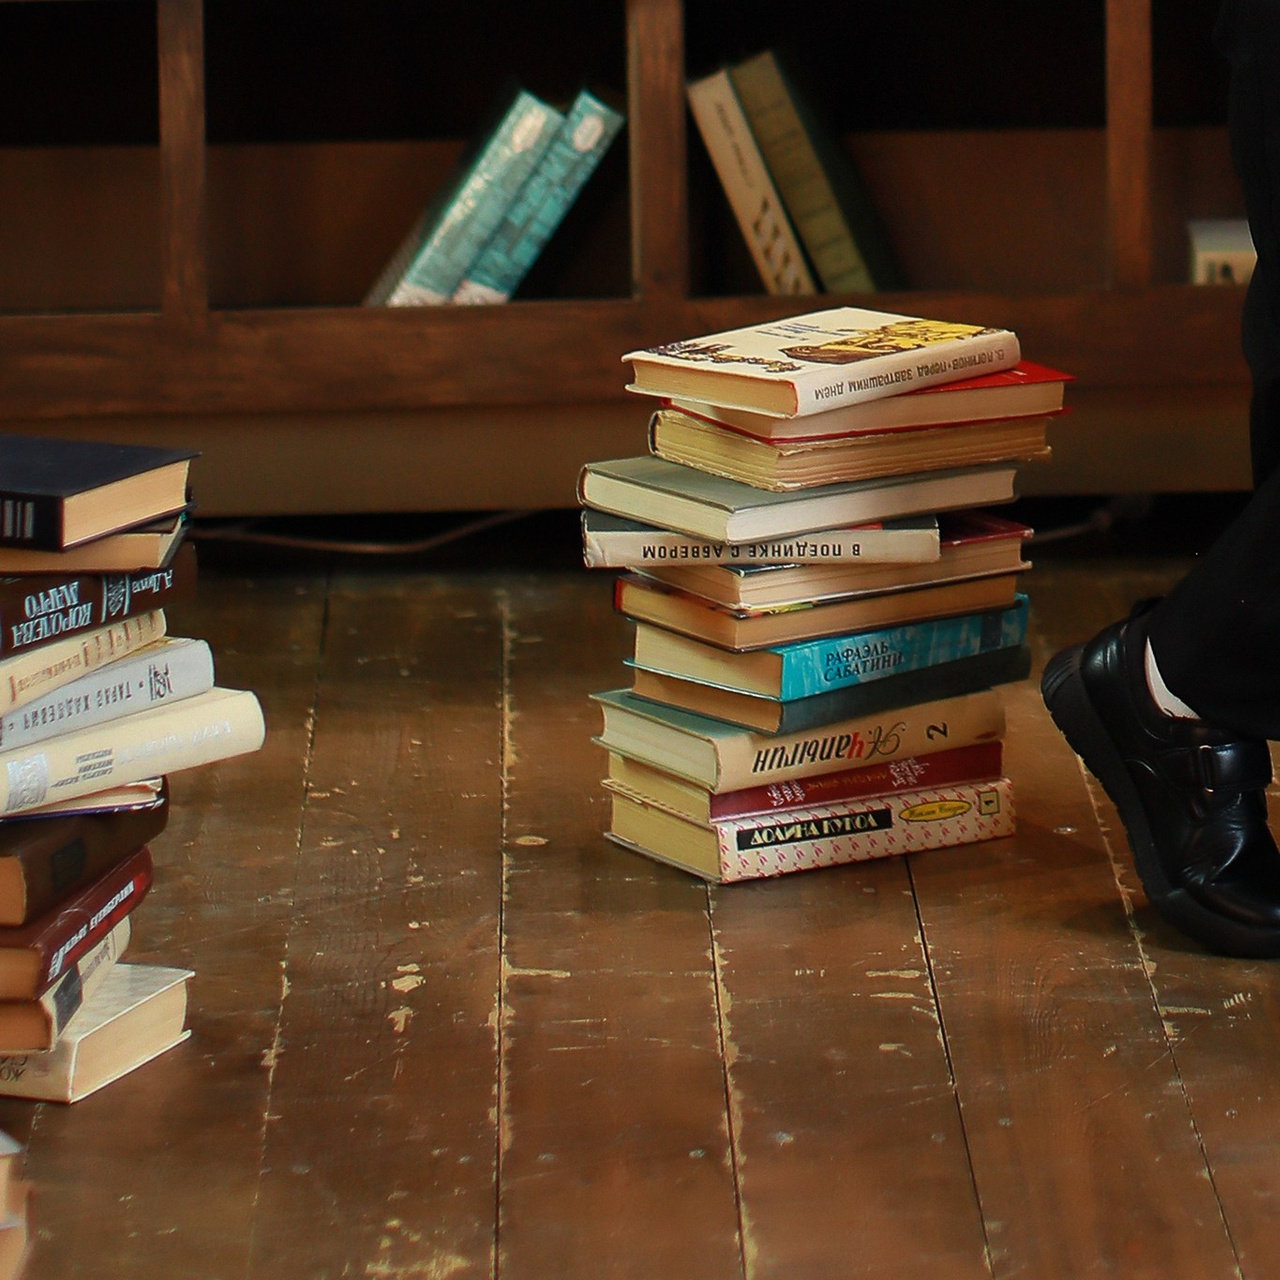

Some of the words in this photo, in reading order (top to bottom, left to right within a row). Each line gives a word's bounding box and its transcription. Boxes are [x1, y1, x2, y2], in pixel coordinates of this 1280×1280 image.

[643, 544, 723, 560] АБВЕРОМ
[731, 546, 740, 558] С
[749, 543, 842, 558] ПОЕДИНКЕ
[852, 544, 861, 556] В
[24, 581, 79, 619] МАРГО
[11, 602, 93, 649] КОРОЛЕВА
[825, 641, 889, 667] РАФАЭЛЬ
[824, 651, 903, 683] САБАТИНИ
[926, 722, 949, 741] 2
[750, 825, 820, 846] ДОЛИНА
[823, 813, 879, 835] КУКОЛ
